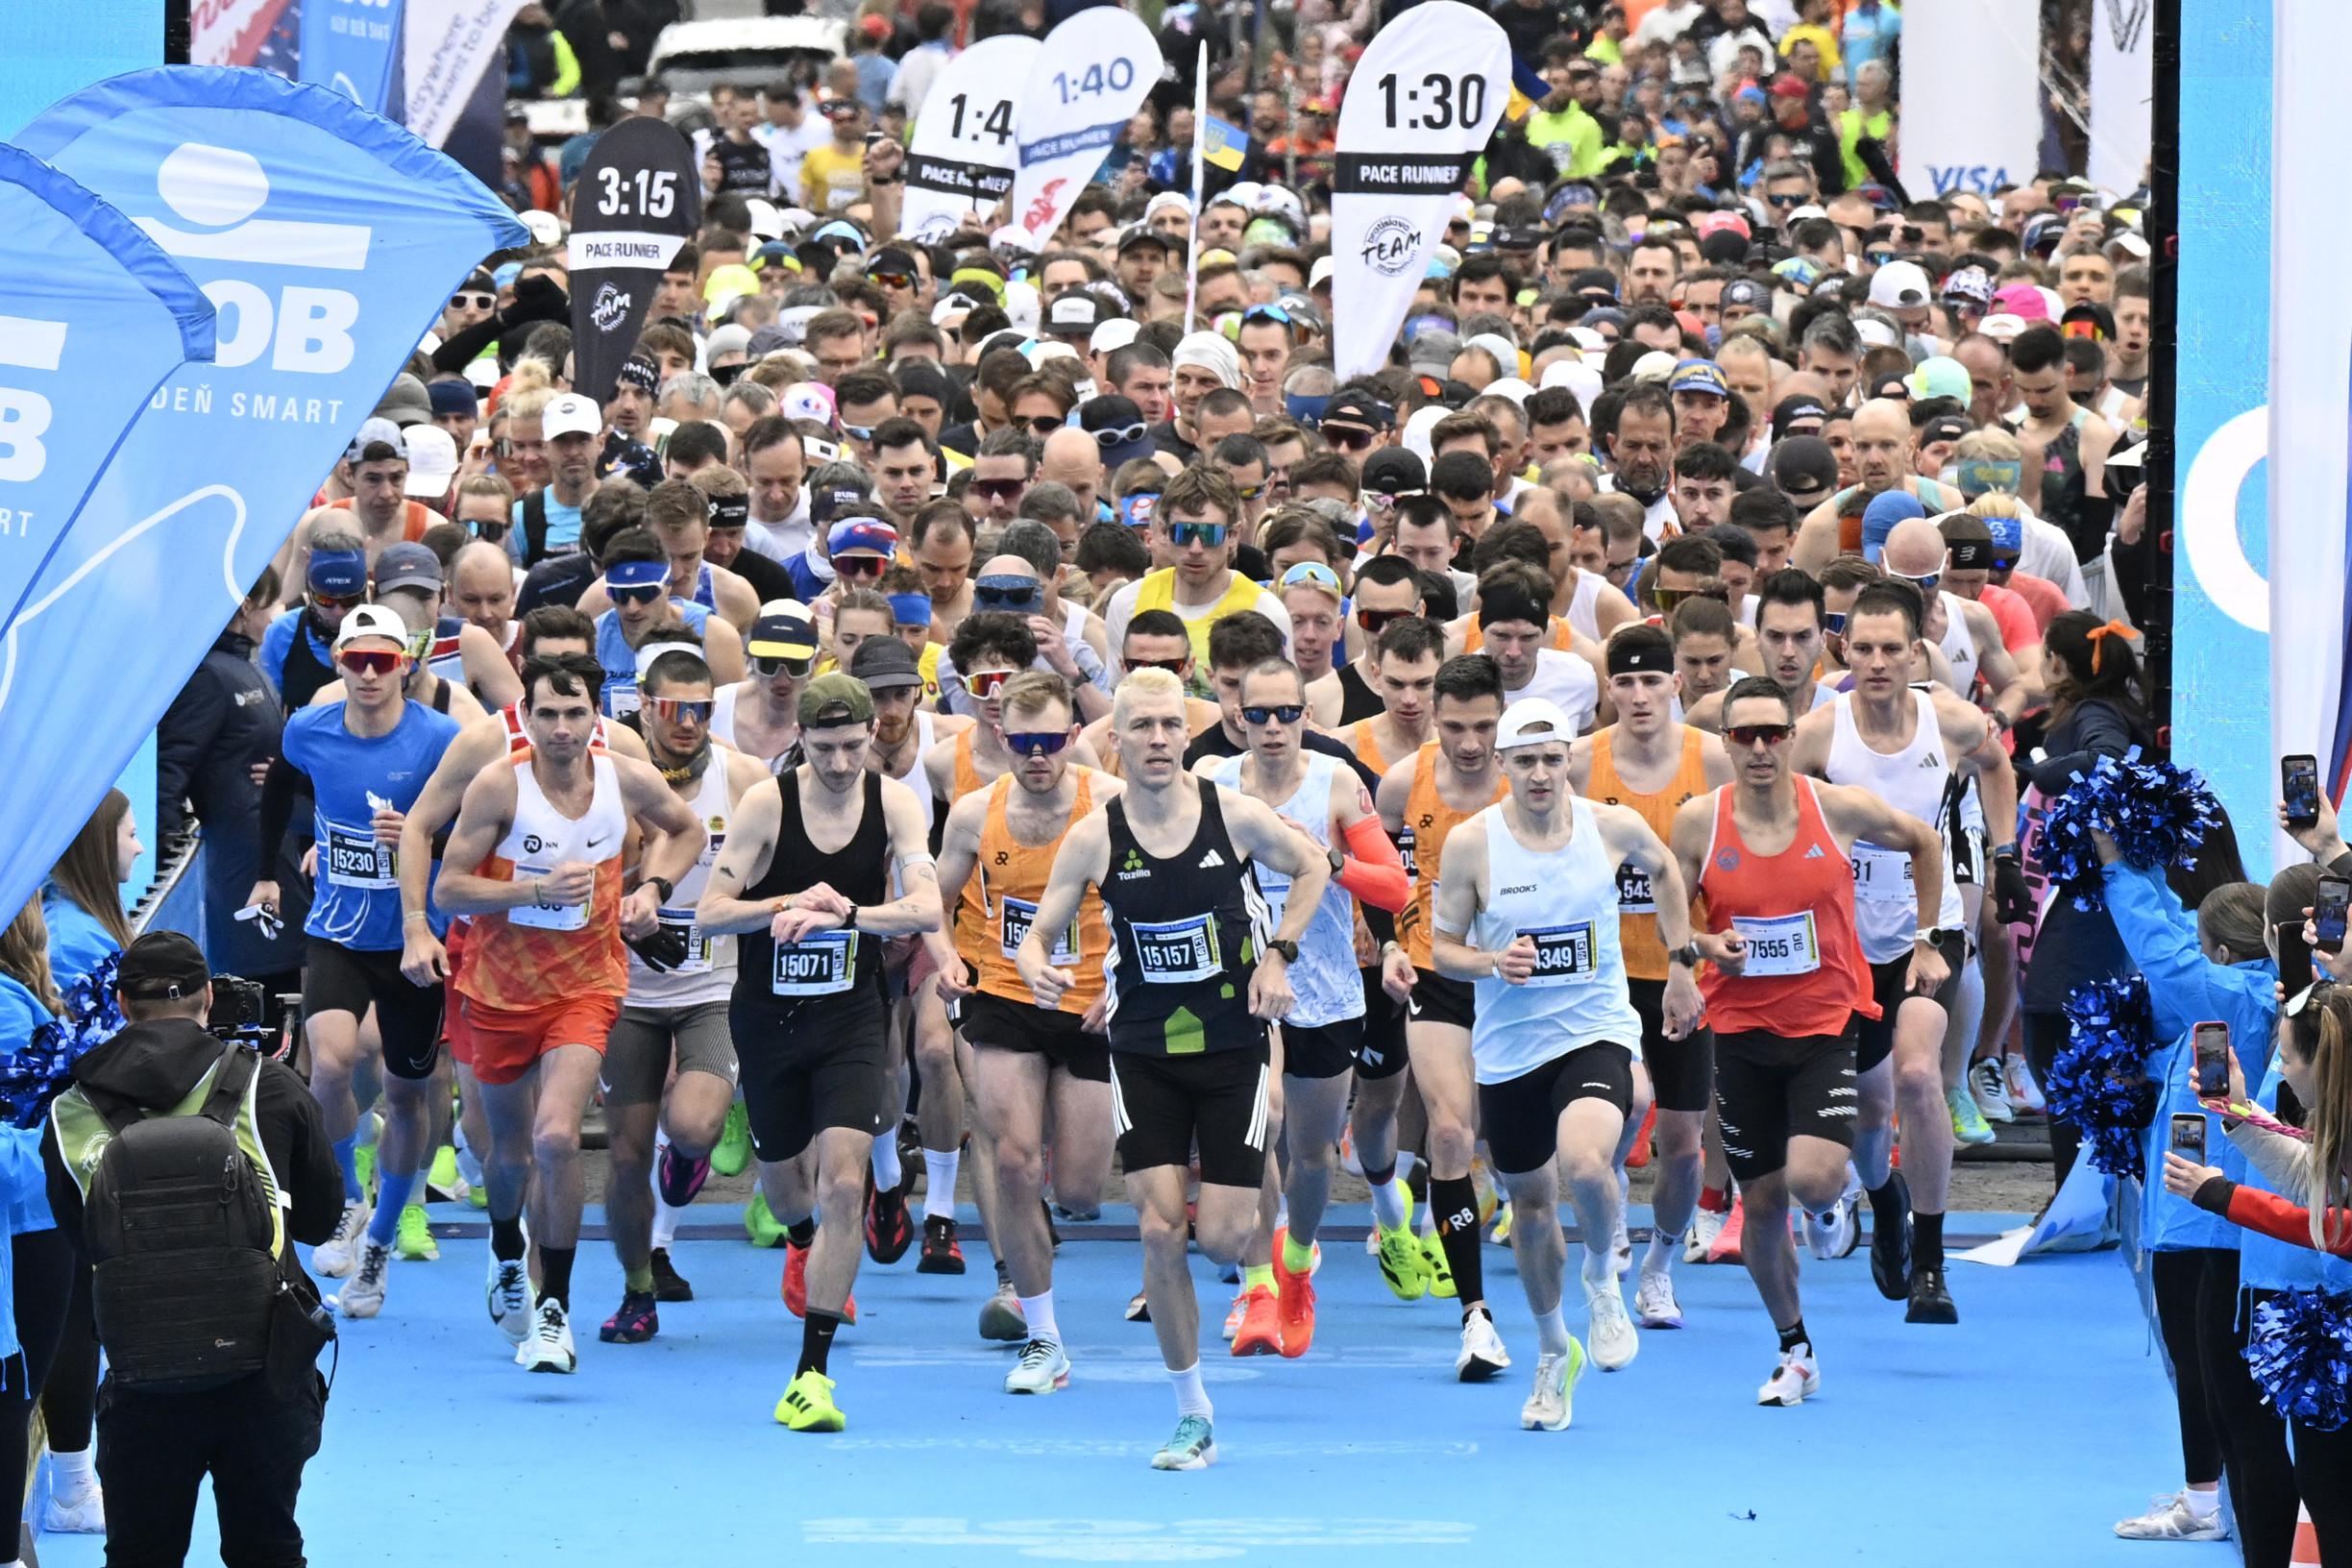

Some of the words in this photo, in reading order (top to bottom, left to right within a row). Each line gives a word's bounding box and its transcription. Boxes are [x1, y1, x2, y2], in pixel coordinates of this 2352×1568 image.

[1052, 56, 1135, 105] 1:40
[1378, 73, 1487, 131] 1:30
[950, 92, 1015, 145] 1:4
[920, 163, 957, 185] PACE
[1360, 164, 1399, 184] PACE
[1924, 164, 2008, 195] VISA
[597, 166, 678, 219] 3:15
[585, 243, 612, 258] PACE
[1360, 231, 1421, 265] TEAM
[201, 279, 360, 375] OB
[150, 383, 213, 414] DEŇ
[230, 392, 344, 425] SMART
[0, 386, 53, 482] B
[0, 507, 34, 538] RT
[332, 846, 375, 872] 15230
[1117, 869, 1152, 881] Tazilla
[1621, 878, 1653, 900] 543
[1500, 884, 1537, 896] BROOKS
[1006, 920, 1031, 944] 150
[780, 953, 829, 977] 15071
[1142, 943, 1190, 967] 15157
